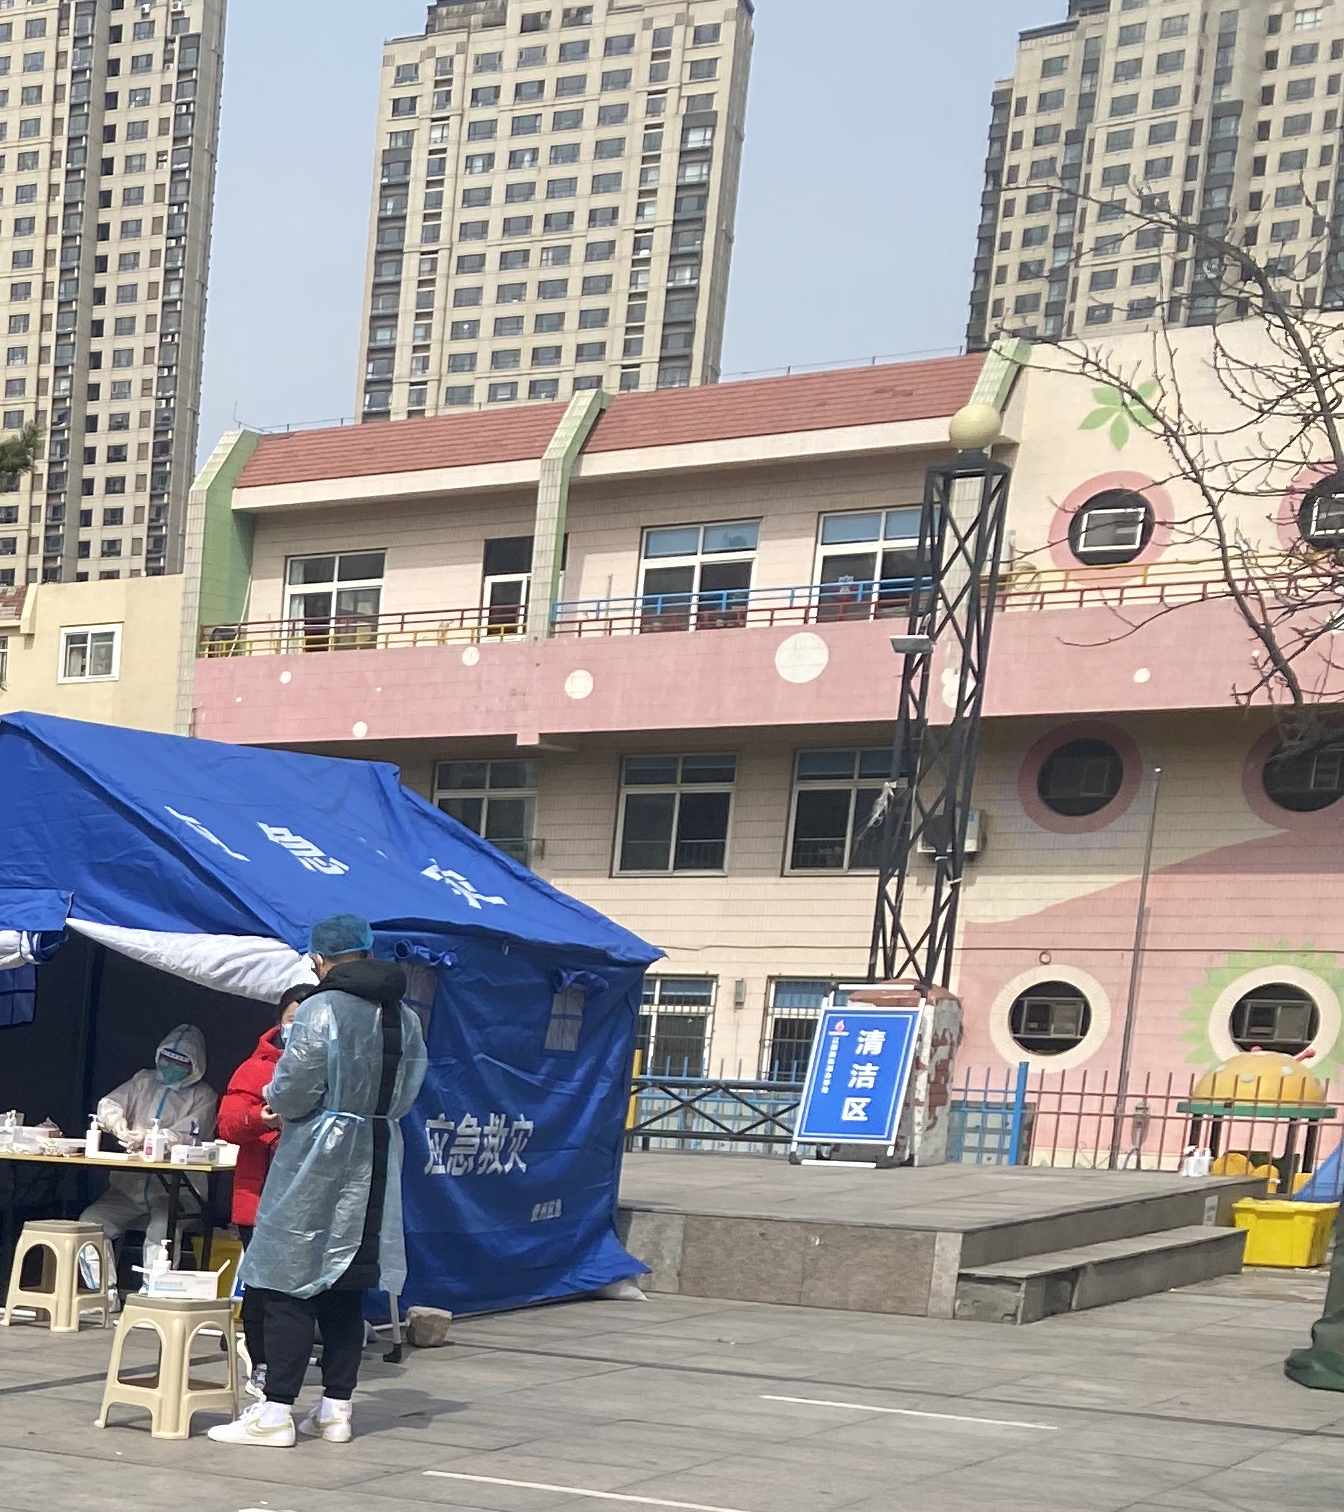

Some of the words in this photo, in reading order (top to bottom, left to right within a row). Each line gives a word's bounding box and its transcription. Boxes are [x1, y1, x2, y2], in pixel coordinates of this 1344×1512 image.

[841, 1029, 887, 1121] 清洁区
[424, 1112, 534, 1176] 应急救灾
